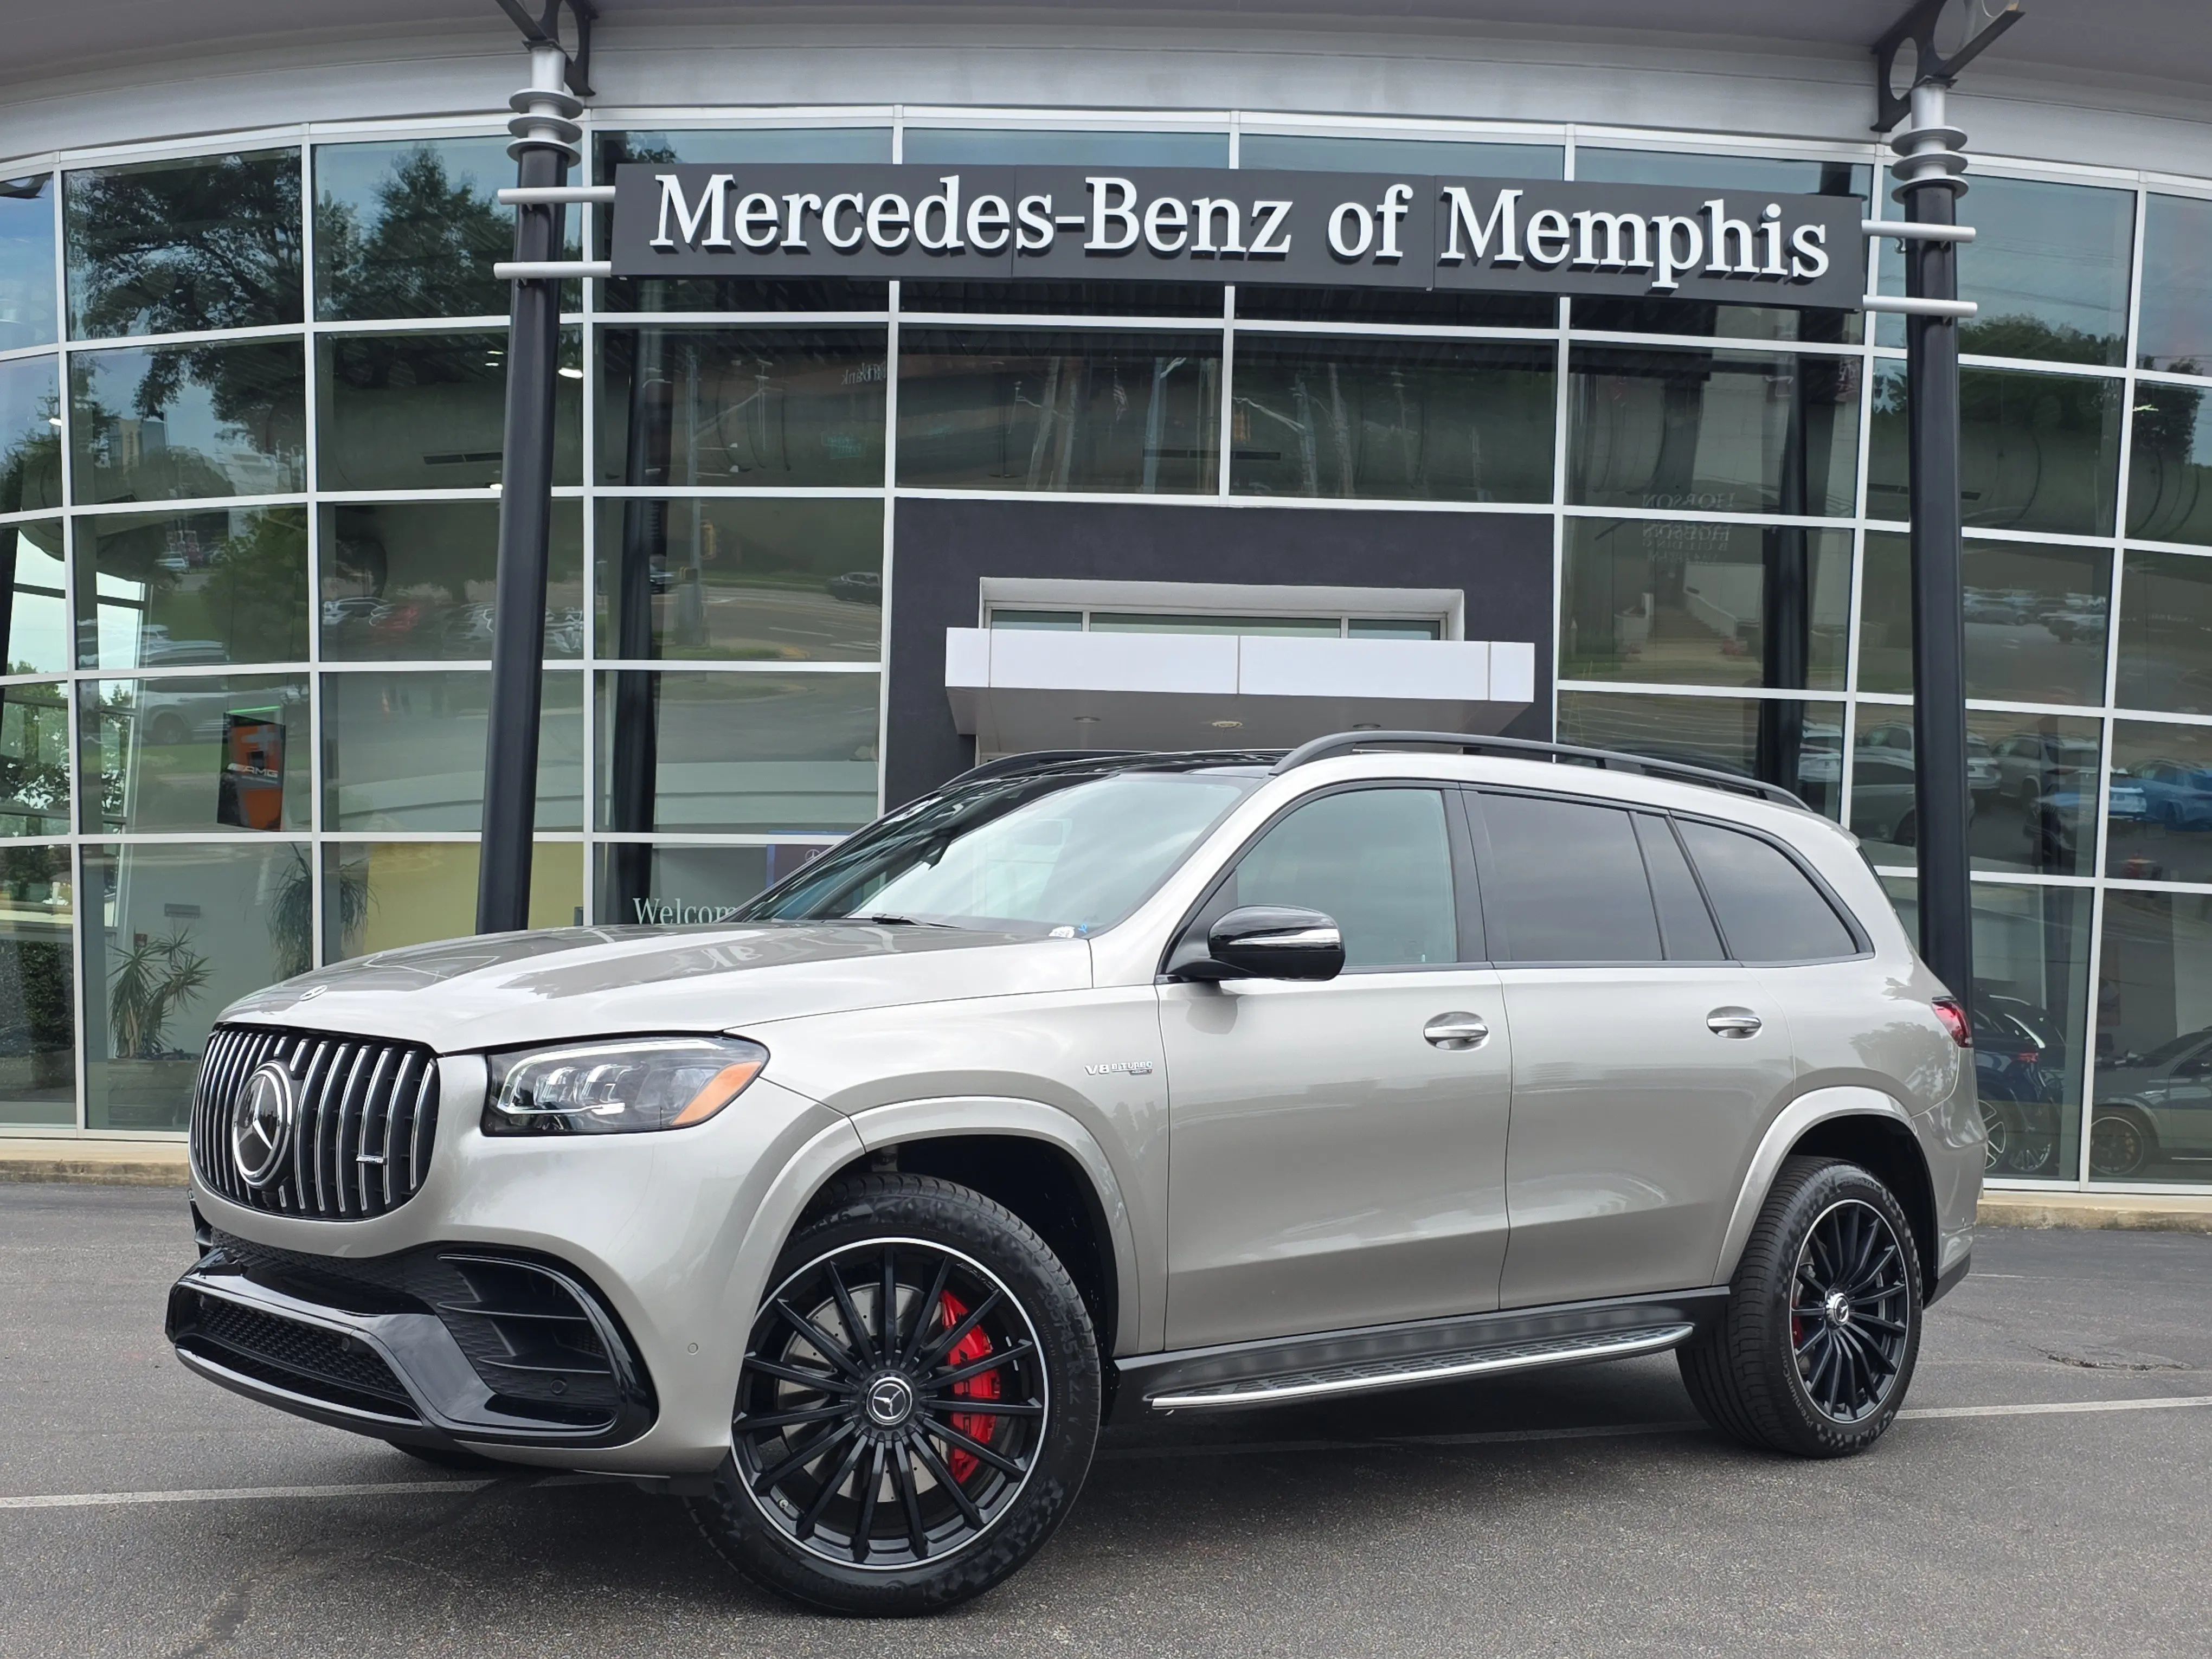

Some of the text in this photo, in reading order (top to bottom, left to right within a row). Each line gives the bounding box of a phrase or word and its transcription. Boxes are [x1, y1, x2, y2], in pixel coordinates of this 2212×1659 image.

[650, 174, 1829, 290] Mercedes-Benz of Memphis
[242, 766, 278, 779] AMG
[1085, 1064, 1109, 1075] V8
